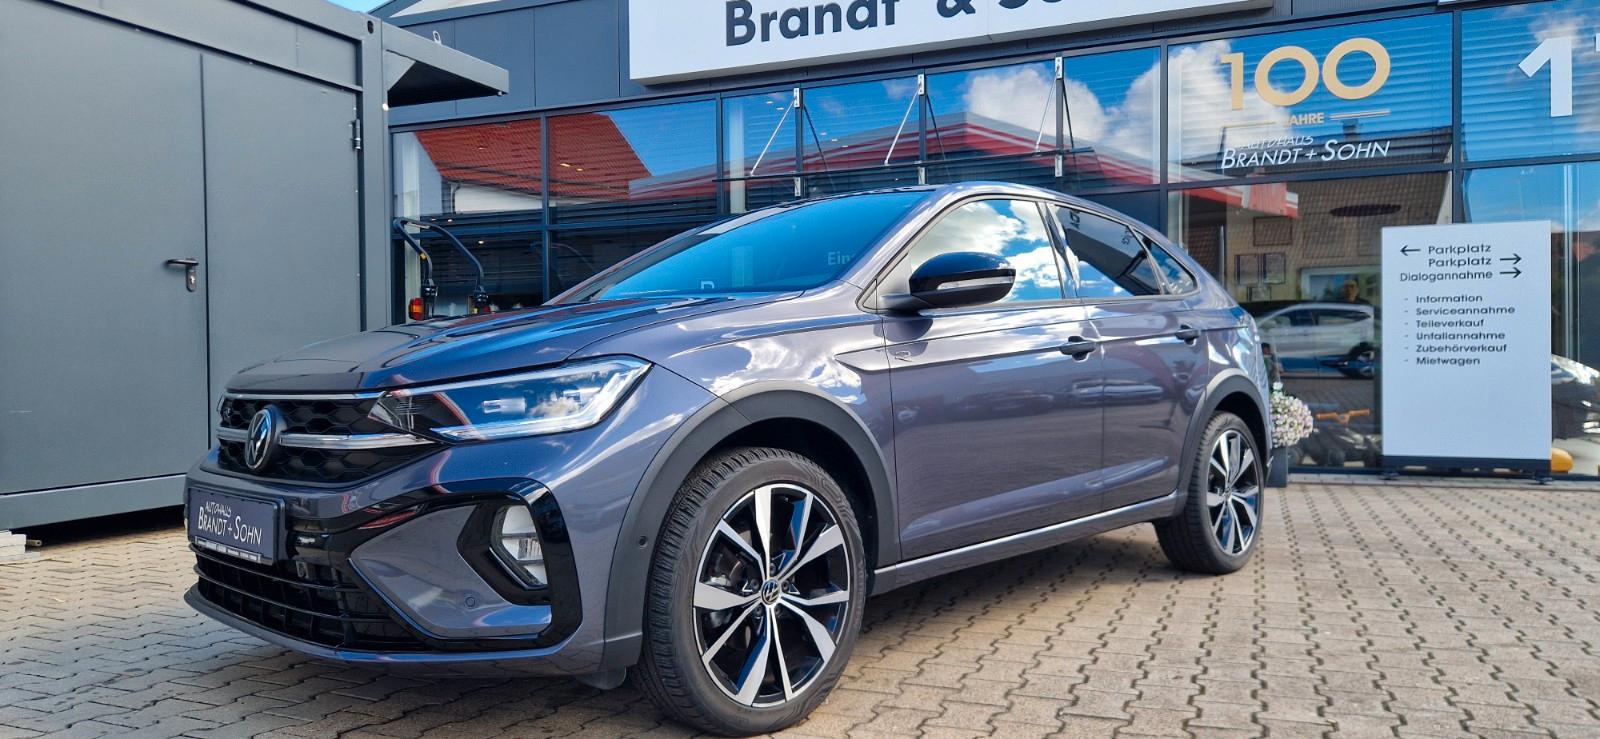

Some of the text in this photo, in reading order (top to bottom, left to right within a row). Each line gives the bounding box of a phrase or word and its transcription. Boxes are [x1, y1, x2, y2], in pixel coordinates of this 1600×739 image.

[725, 0, 900, 47] Brandt
[1221, 37, 1391, 110] 100
[1518, 33, 1600, 118] 1
[1221, 147, 1303, 169] BRANDT
[1321, 139, 1391, 162] SOHN
[1428, 243, 1492, 256] Parkplatz
[828, 251, 856, 265] Ein
[1428, 256, 1492, 268] Parkplatz
[1400, 270, 1493, 283] Dialogannahme
[1416, 294, 1483, 304] Information
[1416, 306, 1515, 316] Serviceannahme
[1416, 319, 1485, 329] Teileverkauf
[1416, 331, 1506, 341] Unfallannahme
[1416, 344, 1507, 353] Zubehörverkauf
[1416, 356, 1480, 367] Mietwagen
[205, 501, 232, 518] AUTOHAUS
[198, 506, 228, 537] BRANDT
[233, 515, 263, 546] SOHN
